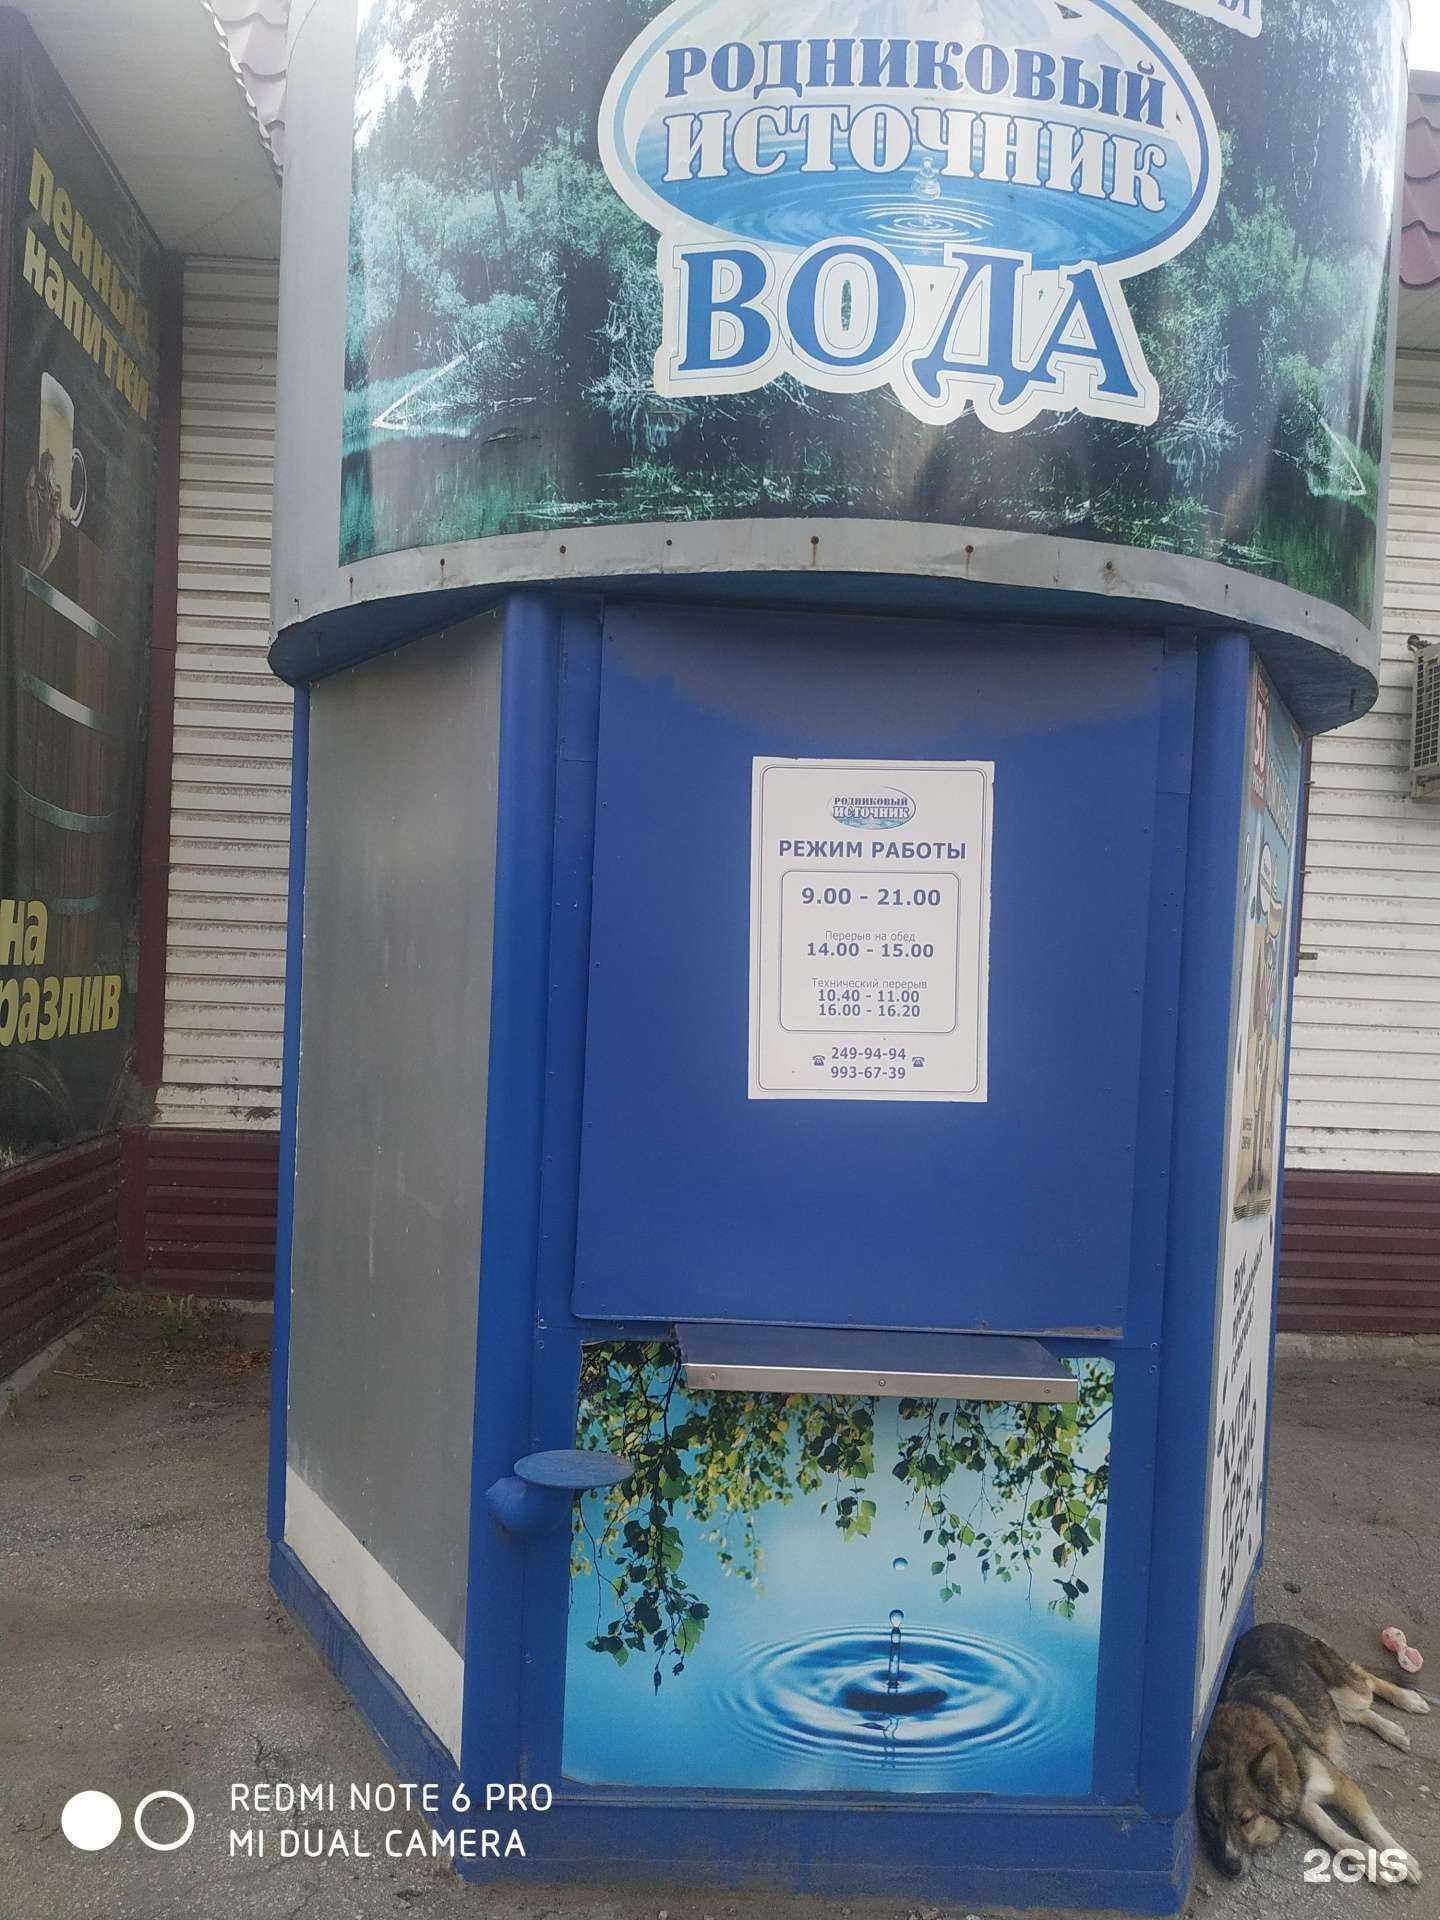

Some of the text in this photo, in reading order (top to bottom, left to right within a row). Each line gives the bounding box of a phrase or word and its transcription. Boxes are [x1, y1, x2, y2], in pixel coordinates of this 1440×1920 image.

[665, 39, 1167, 129] РОДНИКОВЫЙ
[662, 105, 1167, 212] ИСТОЧНИК
[678, 243, 1138, 407] ВОДА
[834, 796, 908, 806] РОДНИКОВЫЙ
[832, 805, 910, 819] ИСТОЧНИК
[779, 840, 967, 860] РЕЖИМ РАБОТЫ
[802, 888, 852, 905] 9.00
[877, 889, 941, 906] 21.00
[825, 930, 915, 943] Перерыв на обед
[807, 942, 860, 957] 14.00
[881, 943, 934, 959] 15.00
[812, 977, 928, 990] Технический перерыв
[818, 989, 860, 1002] 10.40
[878, 990, 920, 1003] 11.00
[819, 1003, 861, 1016] 16.00
[878, 1004, 920, 1017] 16.20
[831, 1046, 906, 1060] 249-94-94
[831, 1066, 906, 1079] 993-67-39
[1221, 1398, 1257, 1559] ПРЯМО
